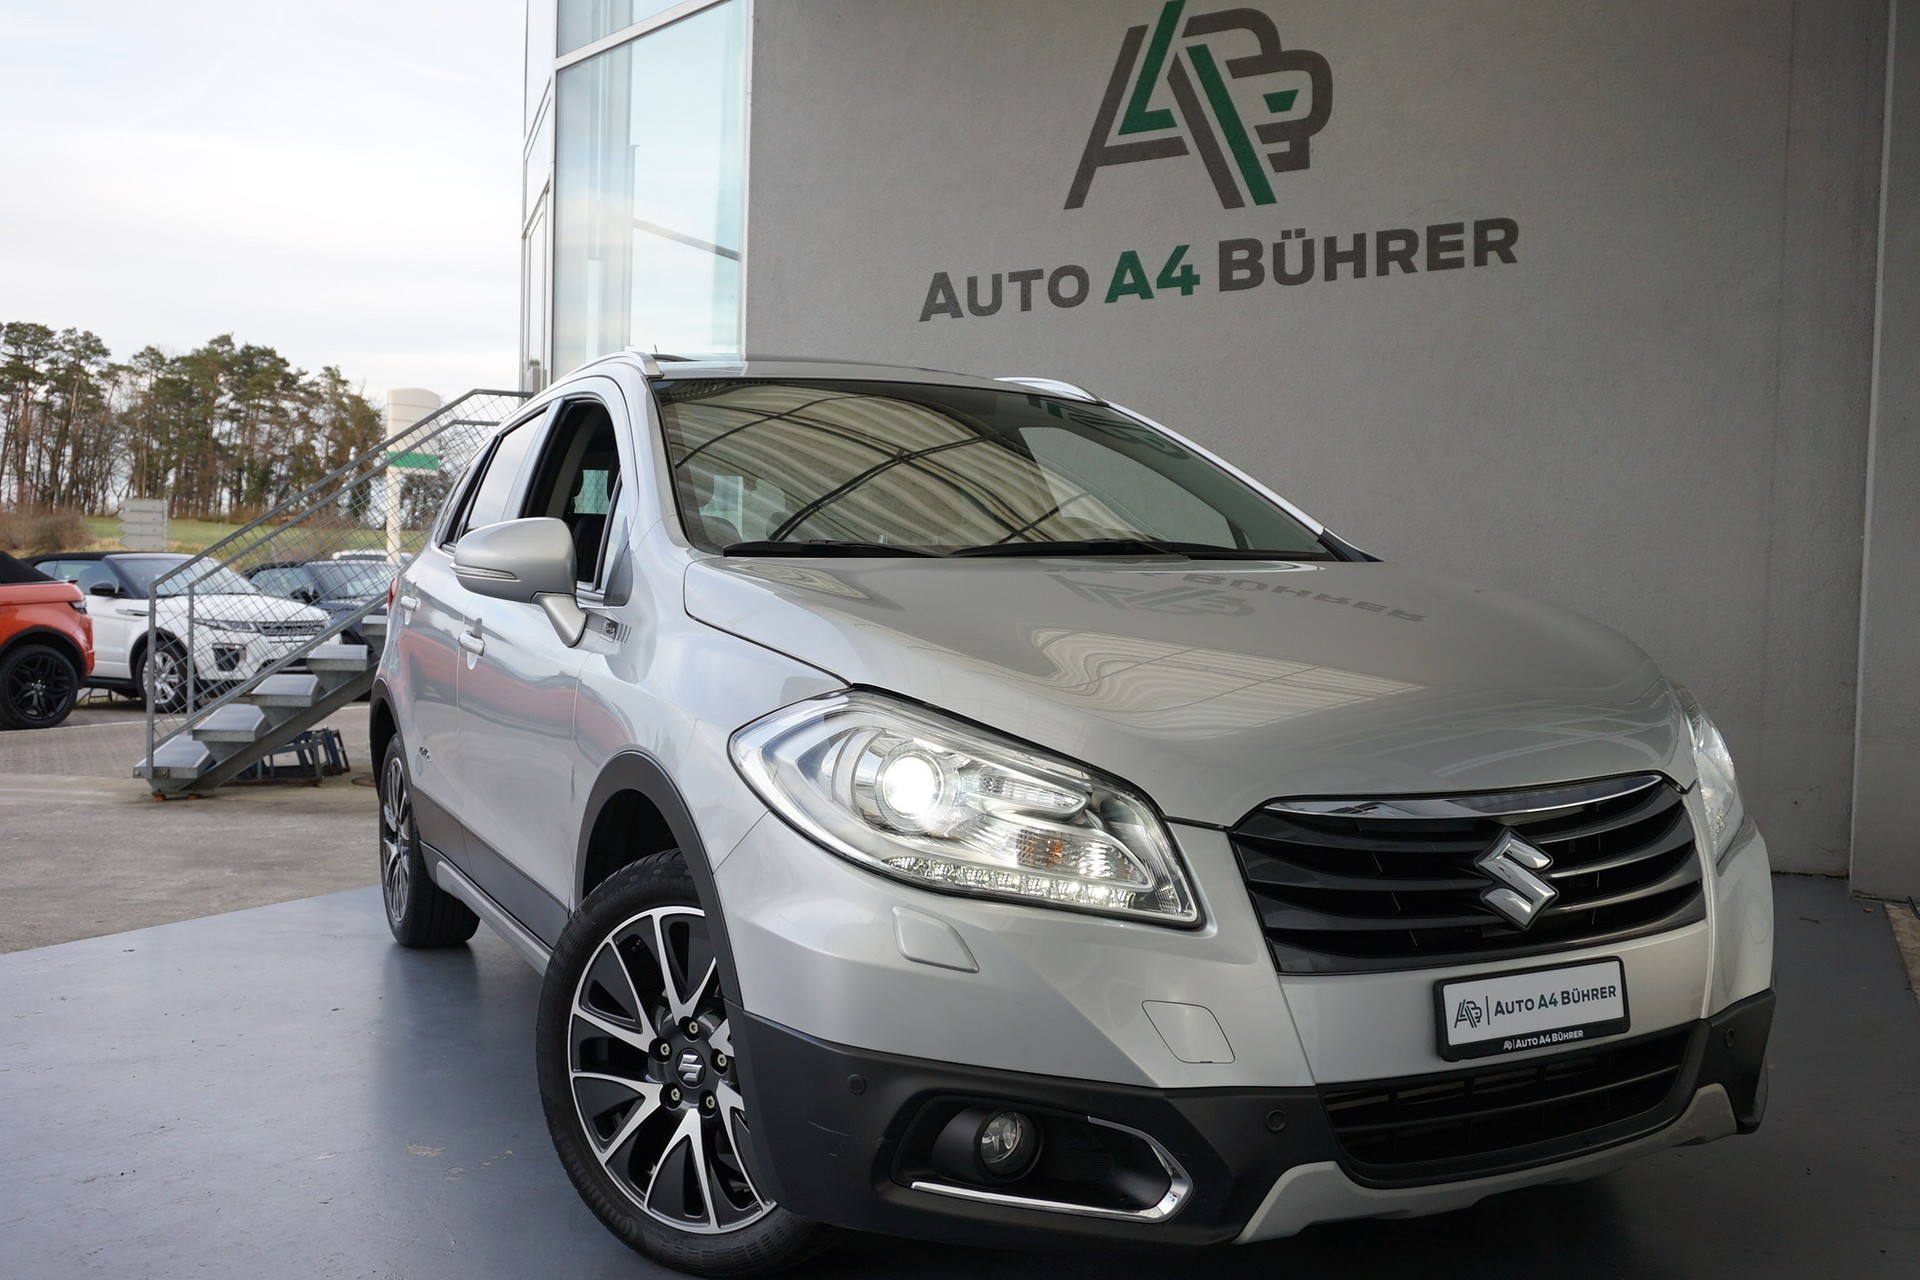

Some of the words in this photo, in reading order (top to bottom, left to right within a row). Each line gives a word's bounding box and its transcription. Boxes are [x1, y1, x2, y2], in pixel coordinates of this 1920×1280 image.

[918, 264, 1091, 322] AUTO
[1104, 244, 1201, 303] A4
[1218, 217, 1519, 292] BÜHRER
[1494, 998, 1535, 1017] AUTO
[1537, 992, 1559, 1009] A4
[1561, 985, 1617, 1006] BÜHRER
[1515, 1038, 1538, 1049] AUTO
[1539, 1035, 1551, 1045] A4
[1552, 1030, 1584, 1042] BÜHRER
